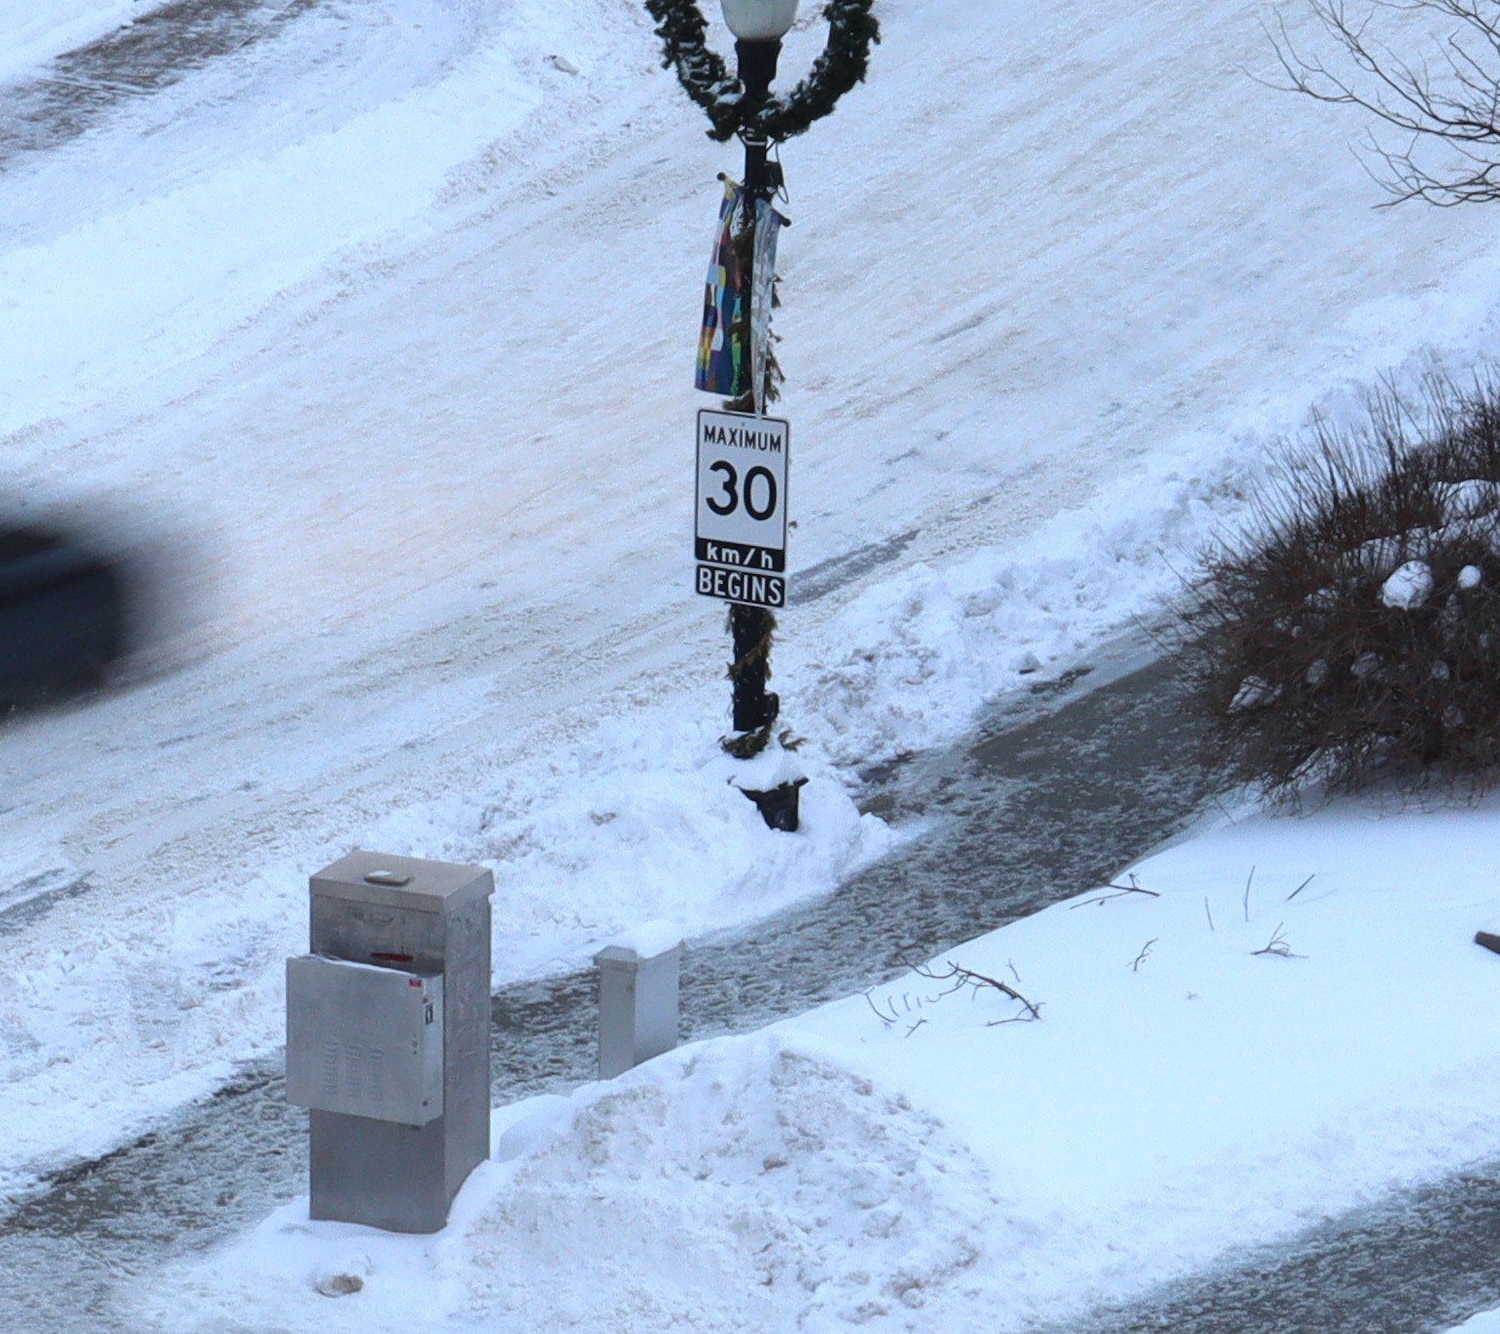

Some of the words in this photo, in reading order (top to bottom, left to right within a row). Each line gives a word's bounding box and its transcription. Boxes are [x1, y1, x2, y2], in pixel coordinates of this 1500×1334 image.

[704, 425, 781, 453] MAXIMUM
[706, 460, 777, 521] 30
[707, 542, 773, 569] km/h
[700, 568, 781, 605] BEGINS
